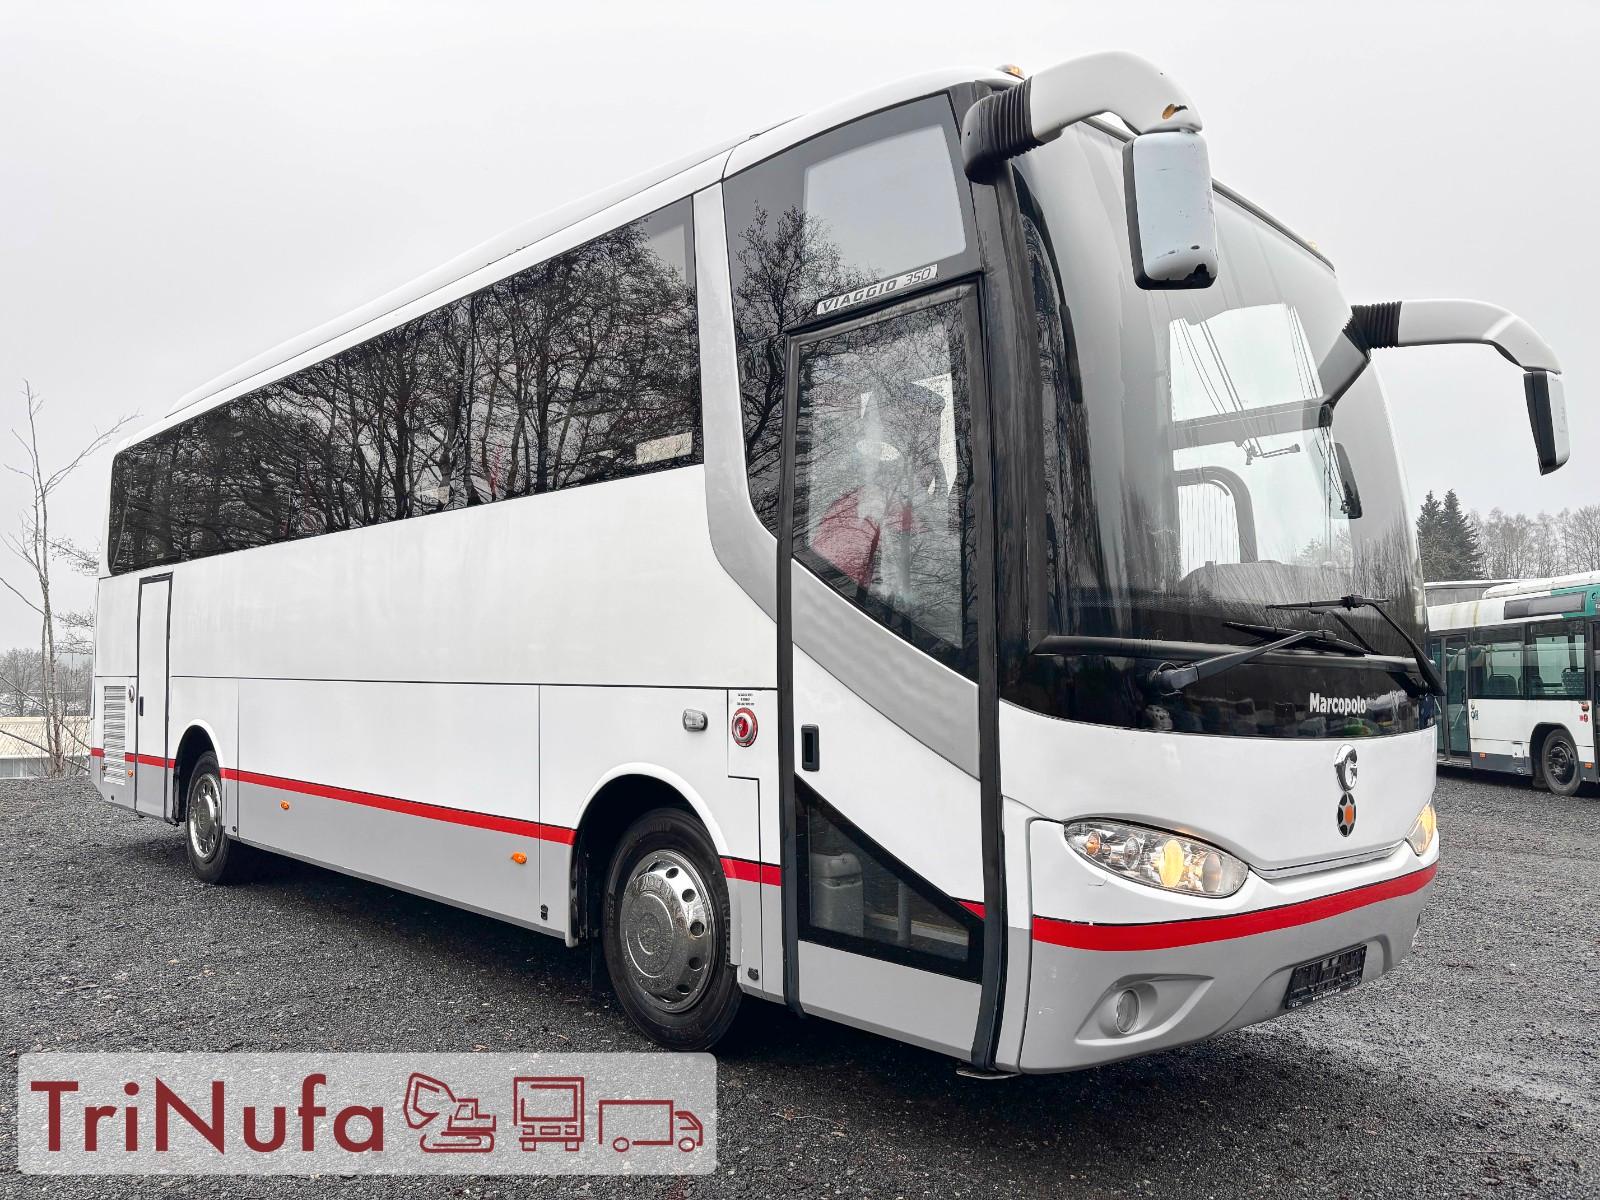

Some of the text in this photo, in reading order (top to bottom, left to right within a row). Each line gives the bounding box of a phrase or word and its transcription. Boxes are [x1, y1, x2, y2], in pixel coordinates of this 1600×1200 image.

[822, 268, 931, 312] VIAGGIO 350
[1309, 692, 1367, 716] Marcopolo
